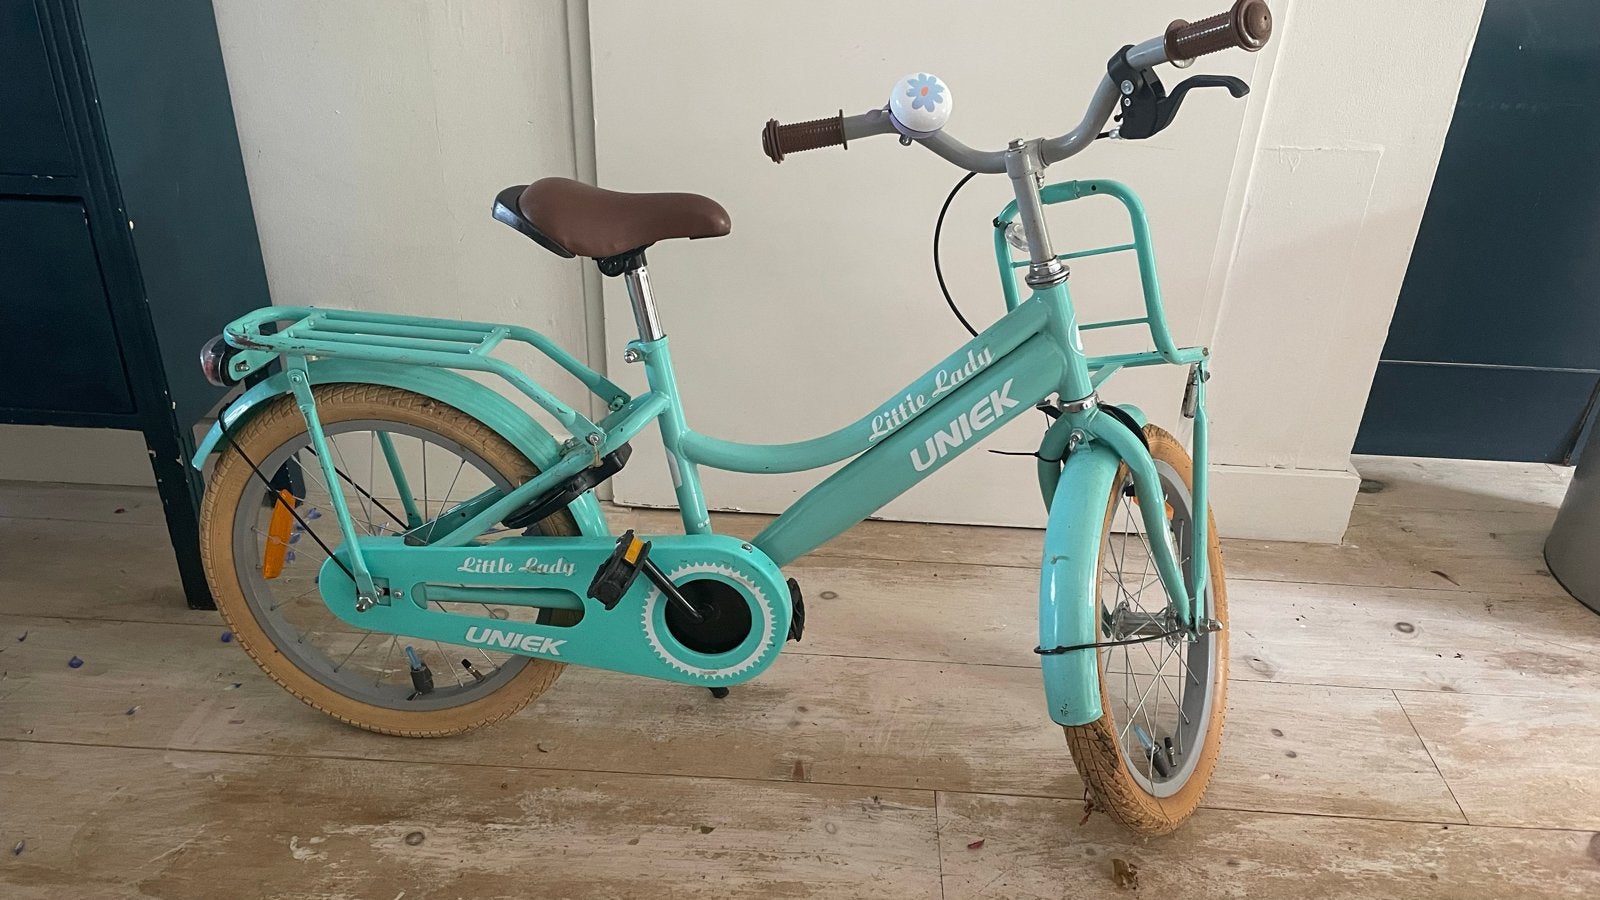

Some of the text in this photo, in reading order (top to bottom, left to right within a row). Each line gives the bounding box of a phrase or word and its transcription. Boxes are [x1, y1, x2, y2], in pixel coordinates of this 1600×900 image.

[869, 347, 996, 442] Little Lady
[910, 378, 1020, 472] UNIEK
[457, 557, 577, 577] Little Lady
[466, 626, 567, 656] UNIEK
